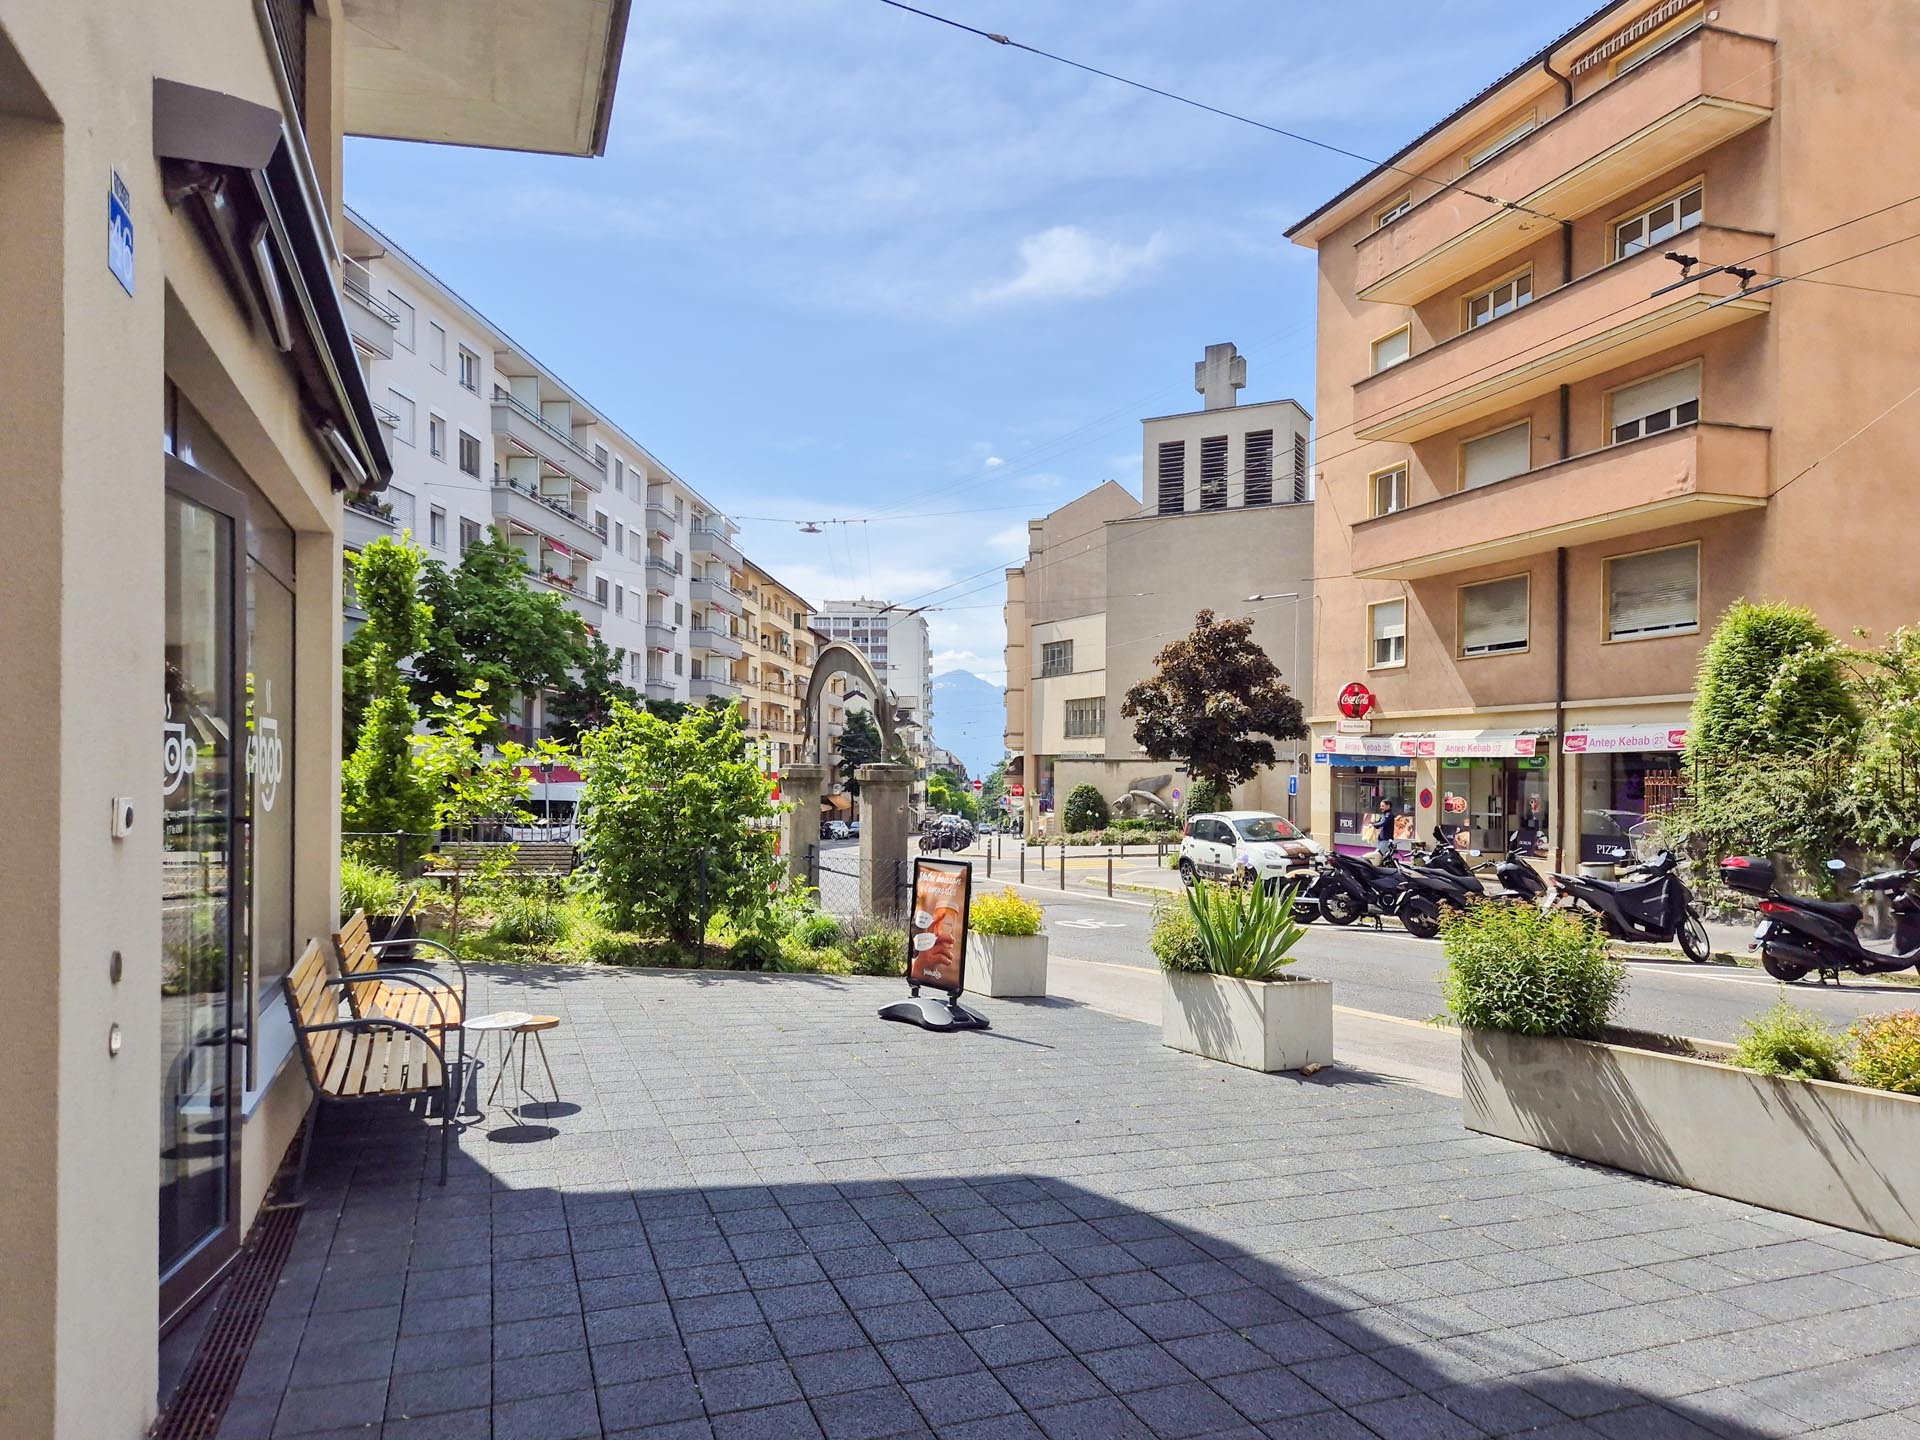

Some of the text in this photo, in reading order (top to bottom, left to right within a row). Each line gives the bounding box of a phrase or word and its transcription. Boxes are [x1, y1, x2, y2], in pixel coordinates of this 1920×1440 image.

[1589, 738, 1616, 748] Antep
[1619, 736, 1650, 746] Kebab
[1654, 737, 1664, 745] 27
[1445, 744, 1465, 753] Antep
[1467, 743, 1491, 752] Kebab
[1340, 818, 1353, 828] PIDE
